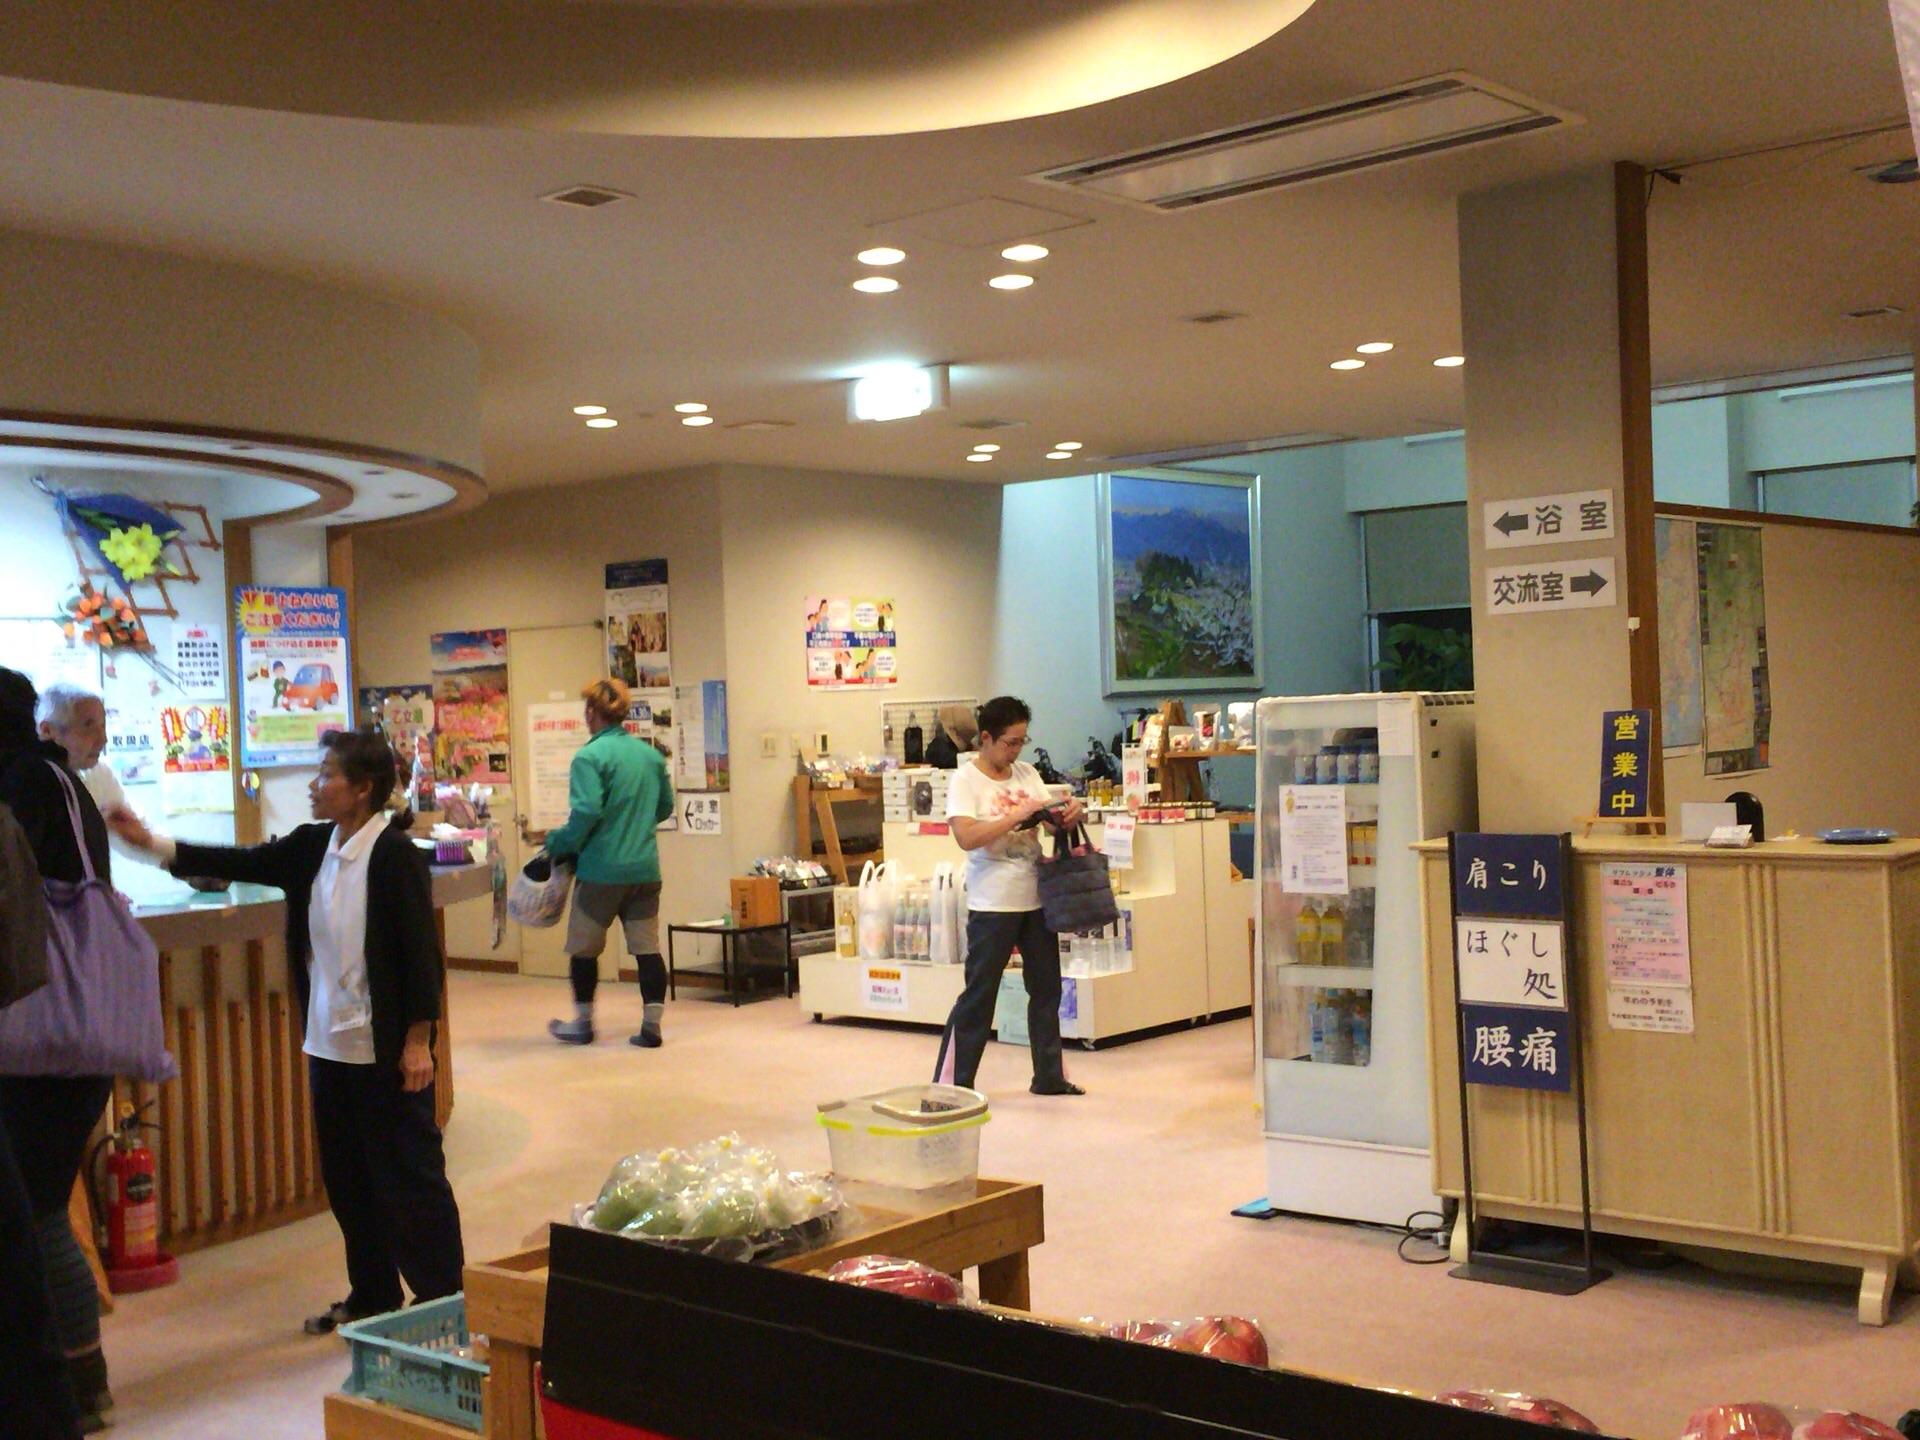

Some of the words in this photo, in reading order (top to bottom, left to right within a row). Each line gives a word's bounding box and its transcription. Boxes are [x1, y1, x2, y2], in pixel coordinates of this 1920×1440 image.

[1535, 500, 1608, 536] 浴室
[1493, 572, 1564, 606] 交流室
[1611, 713, 1640, 816] 営業中
[1465, 857, 1547, 891] 肩こり
[1467, 929, 1549, 958] ほぐし
[1523, 967, 1559, 1000] 処
[1472, 1025, 1558, 1076] 腰痛
